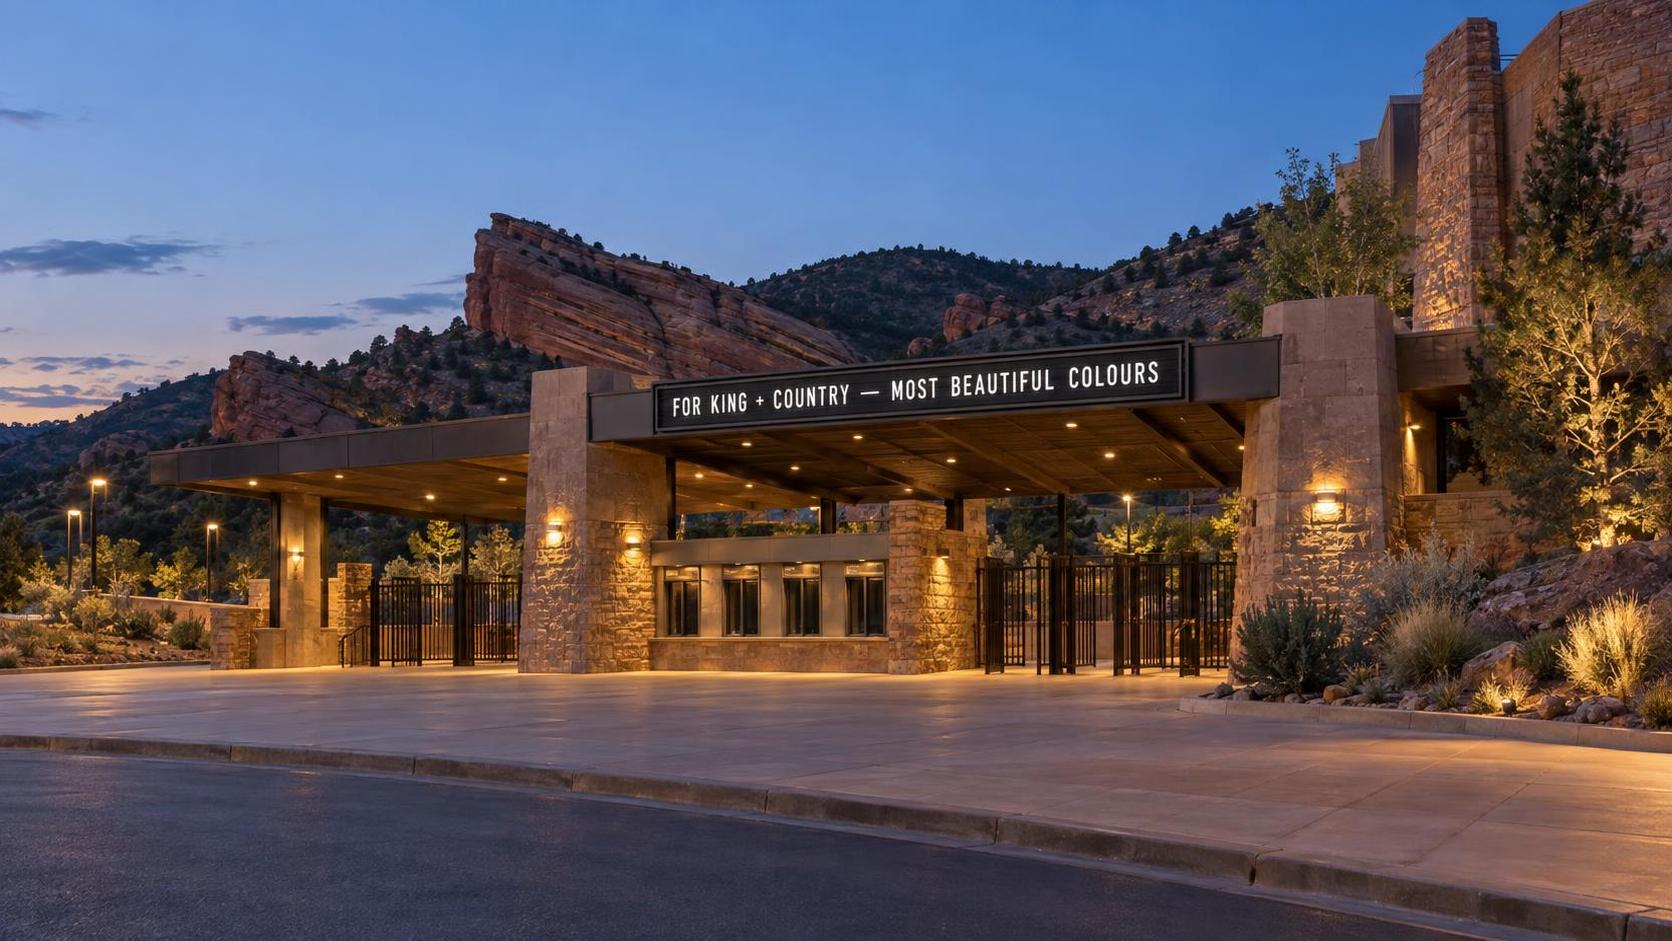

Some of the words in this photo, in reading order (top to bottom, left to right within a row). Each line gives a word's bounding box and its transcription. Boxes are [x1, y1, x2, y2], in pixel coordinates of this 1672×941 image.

[672, 396, 701, 418] FOR
[711, 392, 747, 414] KING
[755, 395, 765, 406] +
[773, 383, 850, 410] COUNTRY
[891, 377, 939, 401] MOST
[951, 368, 1055, 397] BEAUTIFUL
[1068, 361, 1159, 389] COLOURS
